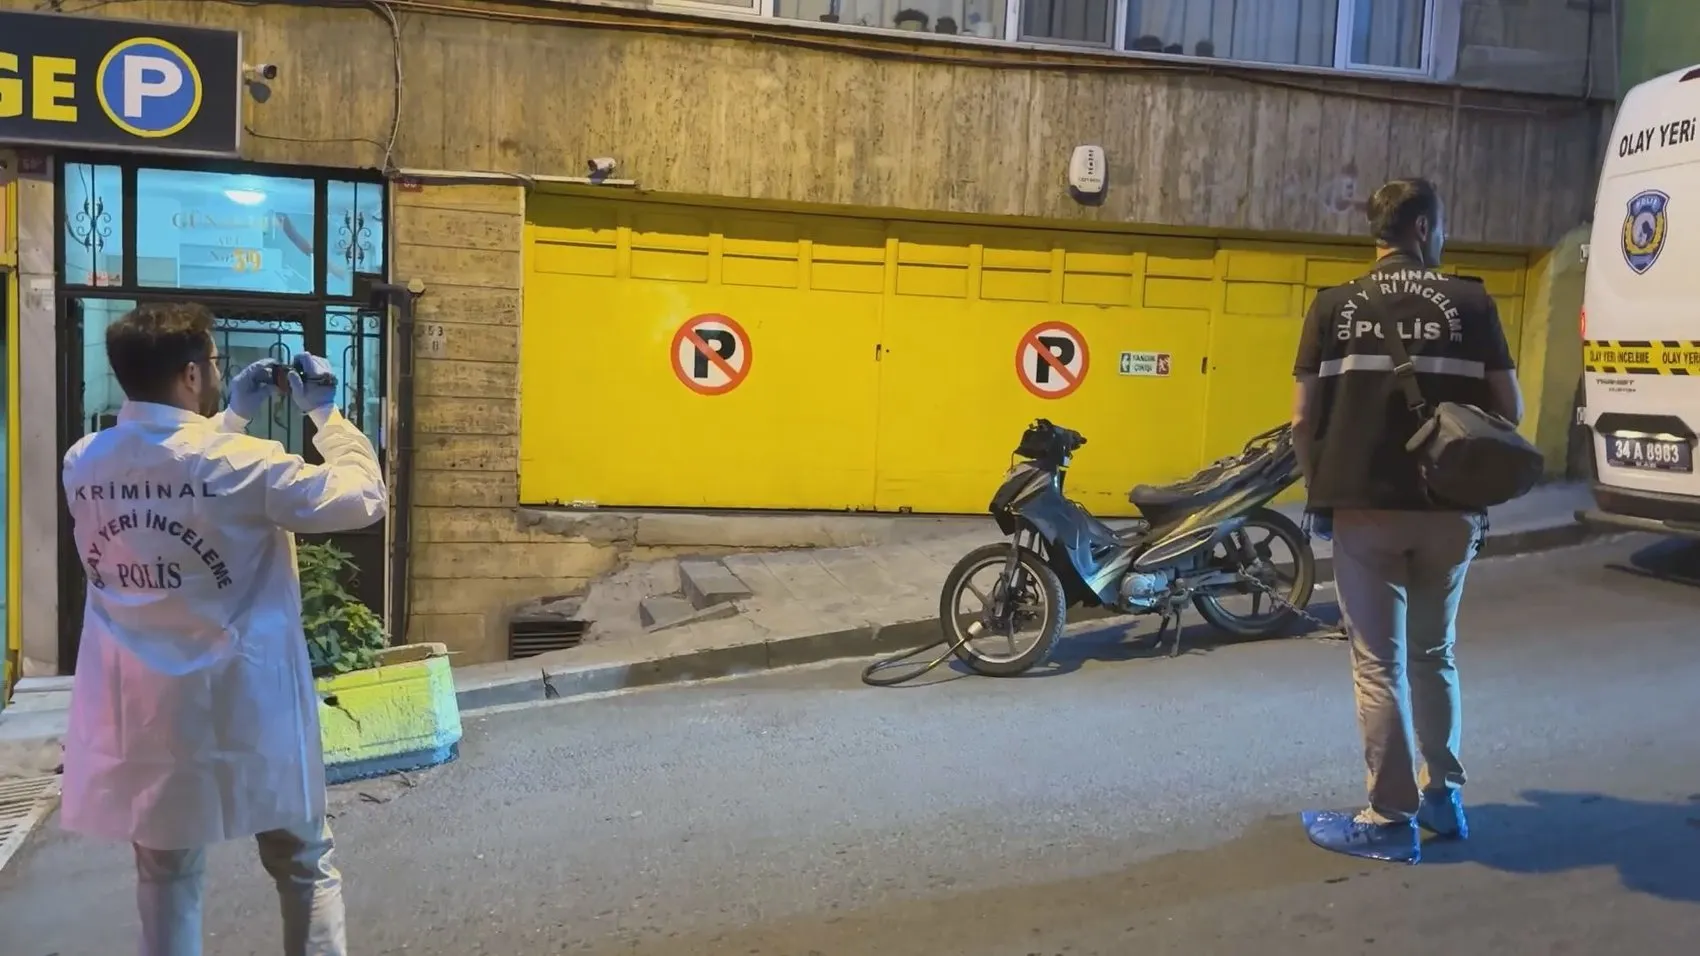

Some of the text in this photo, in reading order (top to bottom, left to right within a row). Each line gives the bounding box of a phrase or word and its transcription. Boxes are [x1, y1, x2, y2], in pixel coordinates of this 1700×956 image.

[124, 55, 183, 118] P
[1619, 117, 1697, 158] OLAY YERİ
[1337, 280, 1463, 342] OLAY YRİ İNCELEME
[694, 329, 736, 378] P
[1036, 336, 1075, 383] P
[1662, 351, 1681, 364] OLAY
[1614, 440, 1631, 459] 34
[1633, 442, 1644, 461] A
[75, 480, 217, 501] KRİMİNAL
[87, 508, 233, 590] OLAY YERİ İNCELEME
[117, 556, 182, 589] POLİS
